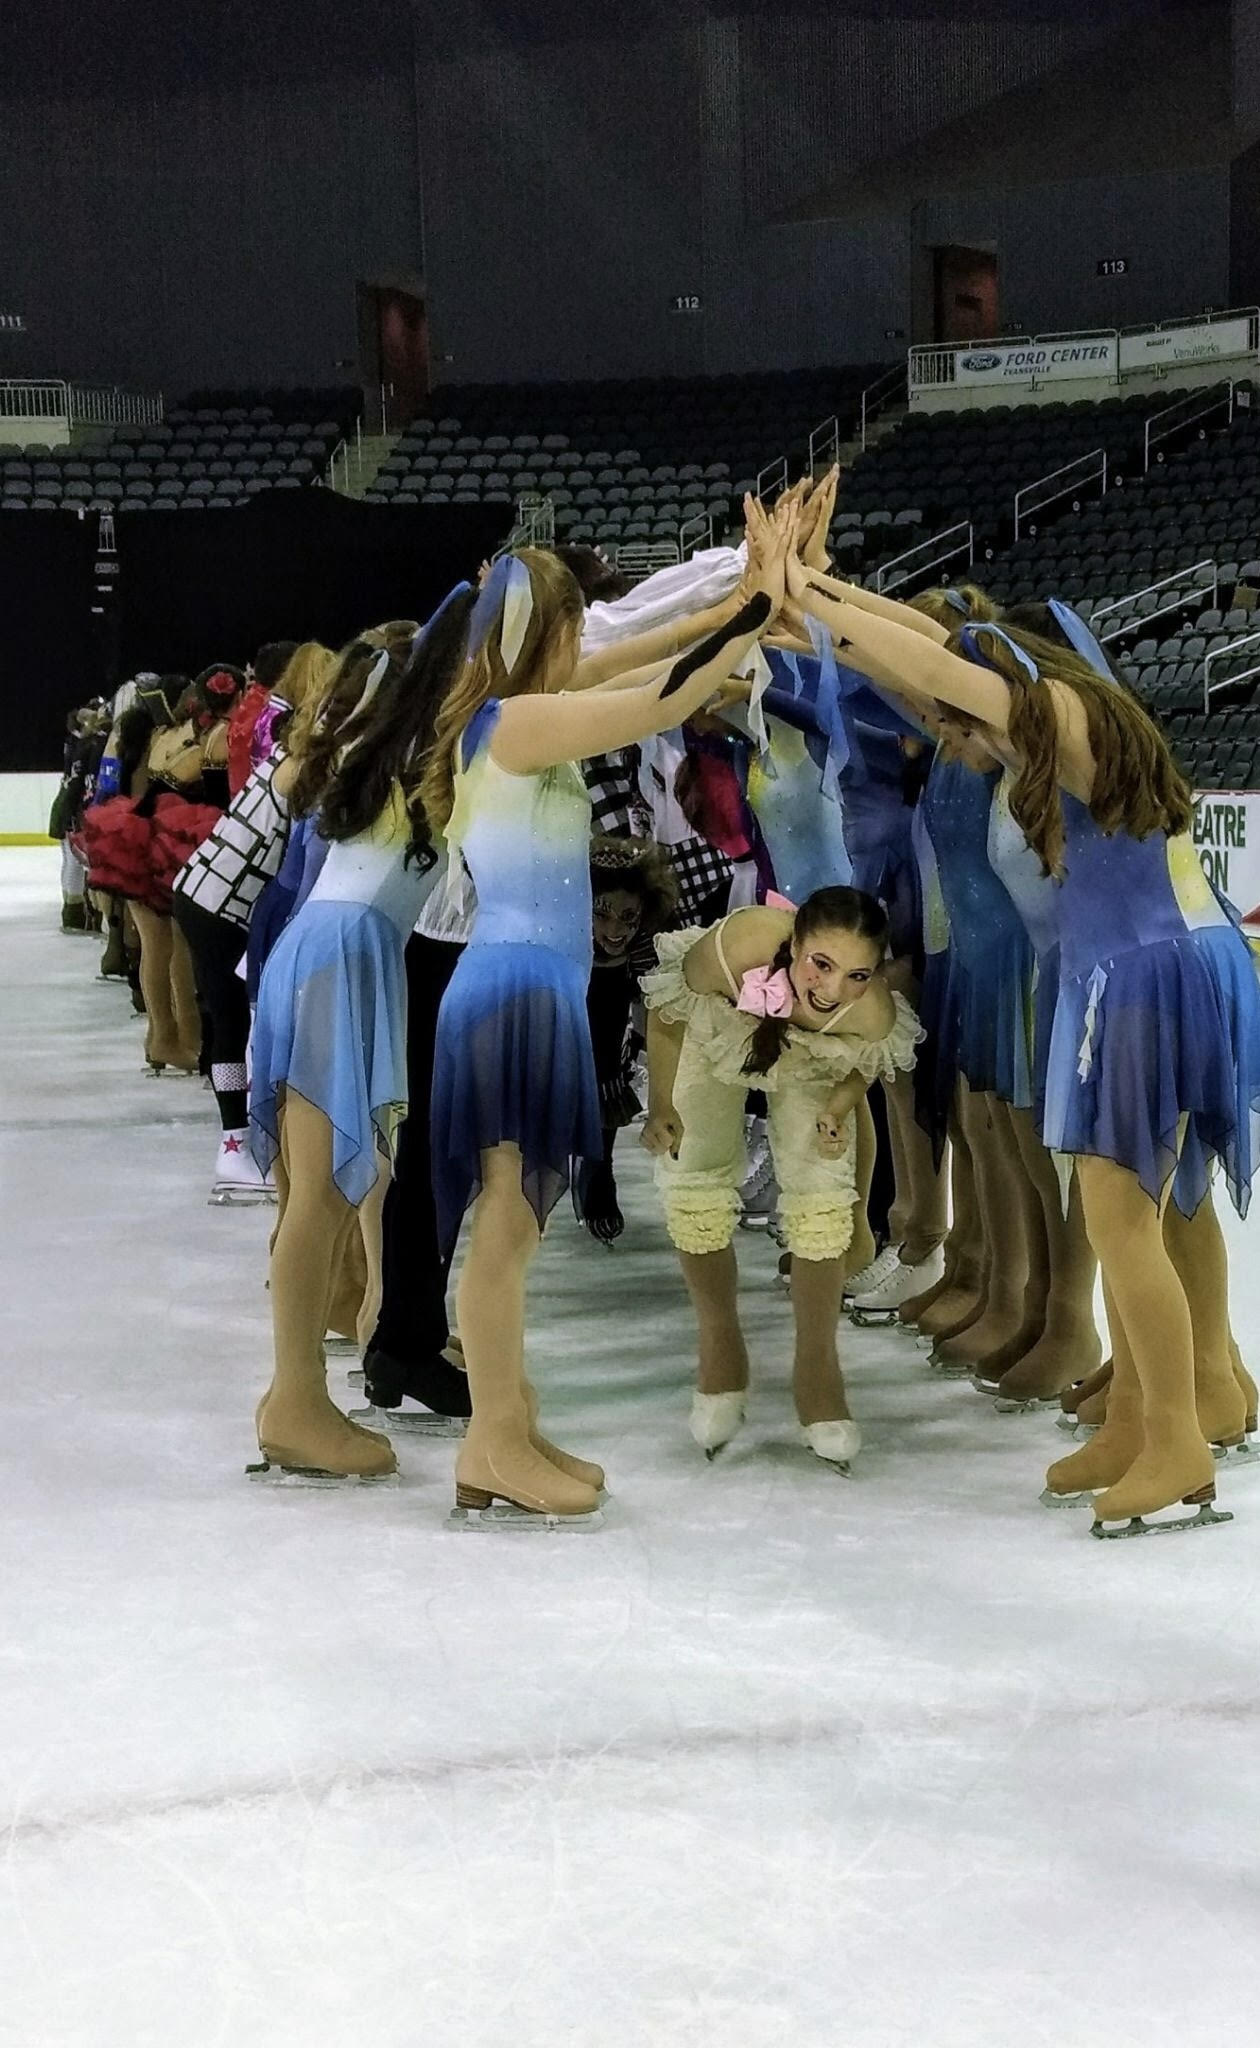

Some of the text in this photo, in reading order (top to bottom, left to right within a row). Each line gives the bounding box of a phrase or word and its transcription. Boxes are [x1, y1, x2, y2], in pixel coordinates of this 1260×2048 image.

[1102, 260, 1126, 274] 113
[676, 296, 700, 309] 112
[0, 315, 21, 327] 111
[1006, 345, 1109, 366] FORD CENTER
[1003, 366, 1051, 376] EVANSVILLE
[1190, 804, 1246, 848] EATRE
[1197, 849, 1229, 892] ON
